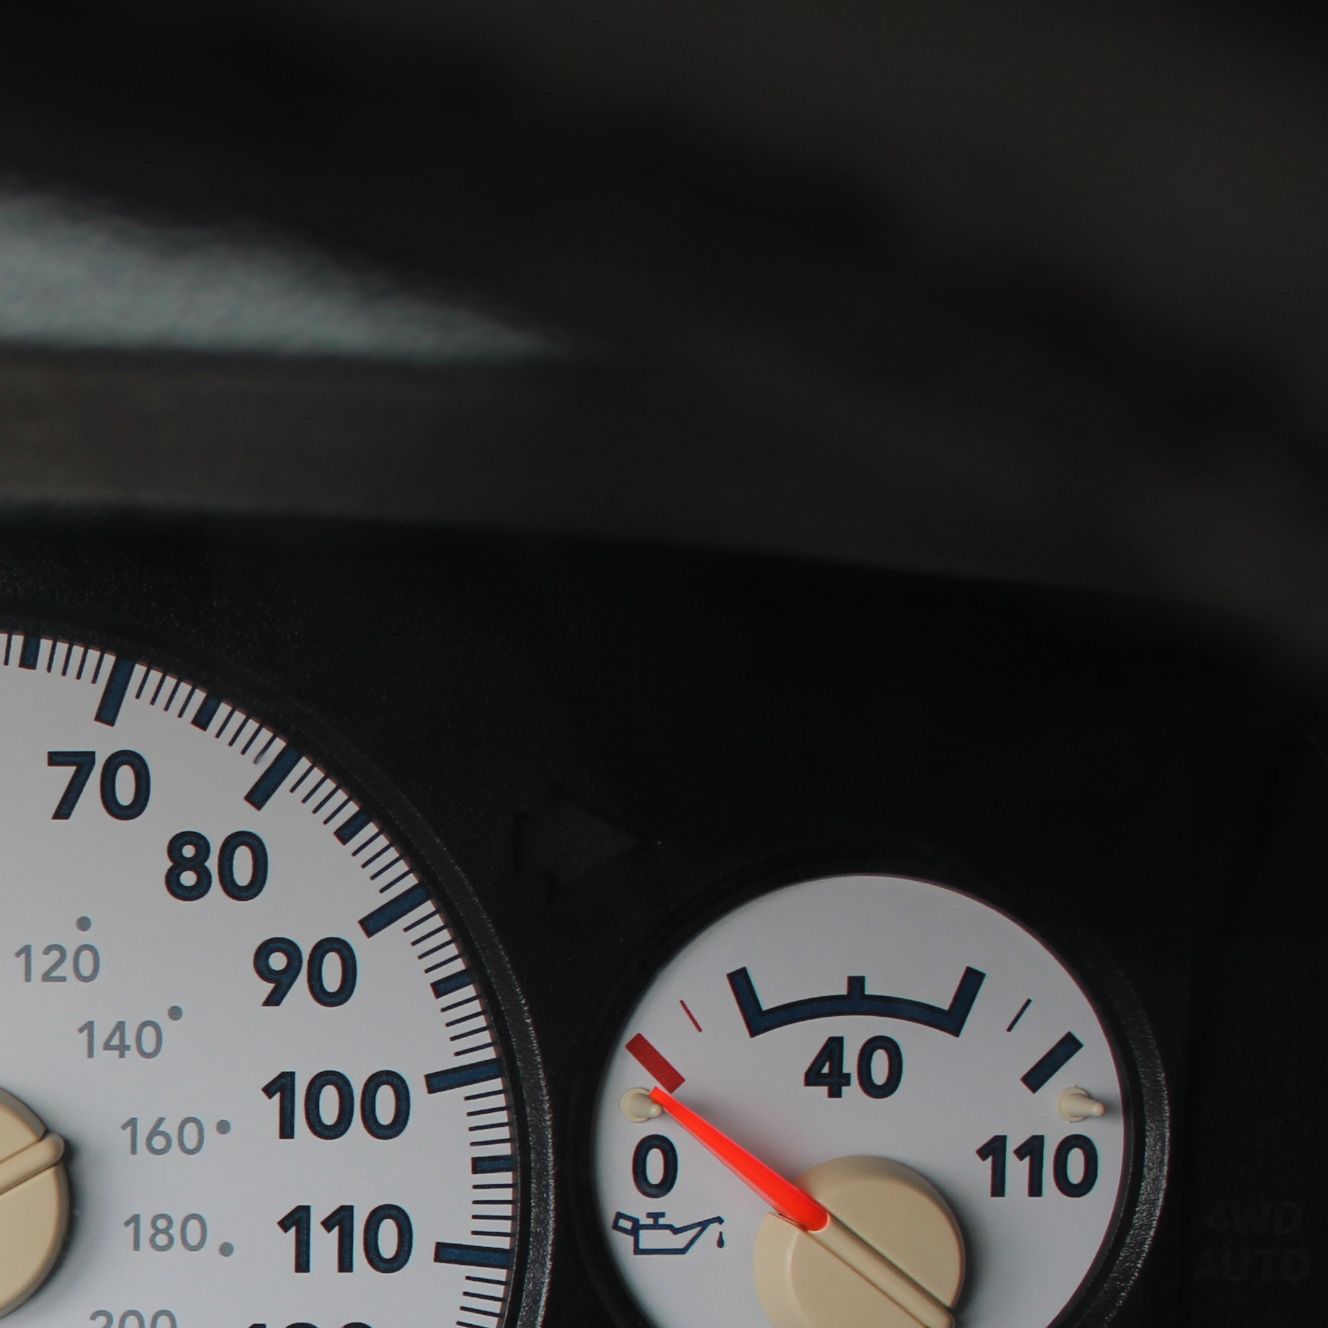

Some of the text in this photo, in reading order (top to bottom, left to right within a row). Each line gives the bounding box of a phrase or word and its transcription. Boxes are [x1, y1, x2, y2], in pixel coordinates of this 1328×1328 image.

[47, 749, 152, 821] 70
[164, 830, 270, 902] 80
[13, 944, 102, 983] 120
[252, 936, 359, 1008] 90
[76, 1019, 164, 1059] 140
[803, 1034, 904, 1099] 40
[119, 1116, 206, 1155] 160
[261, 1069, 412, 1141] 100
[631, 1133, 679, 1199] 0
[975, 1133, 1100, 1198] 110
[122, 1213, 209, 1253] 180
[277, 1203, 415, 1274] 110
